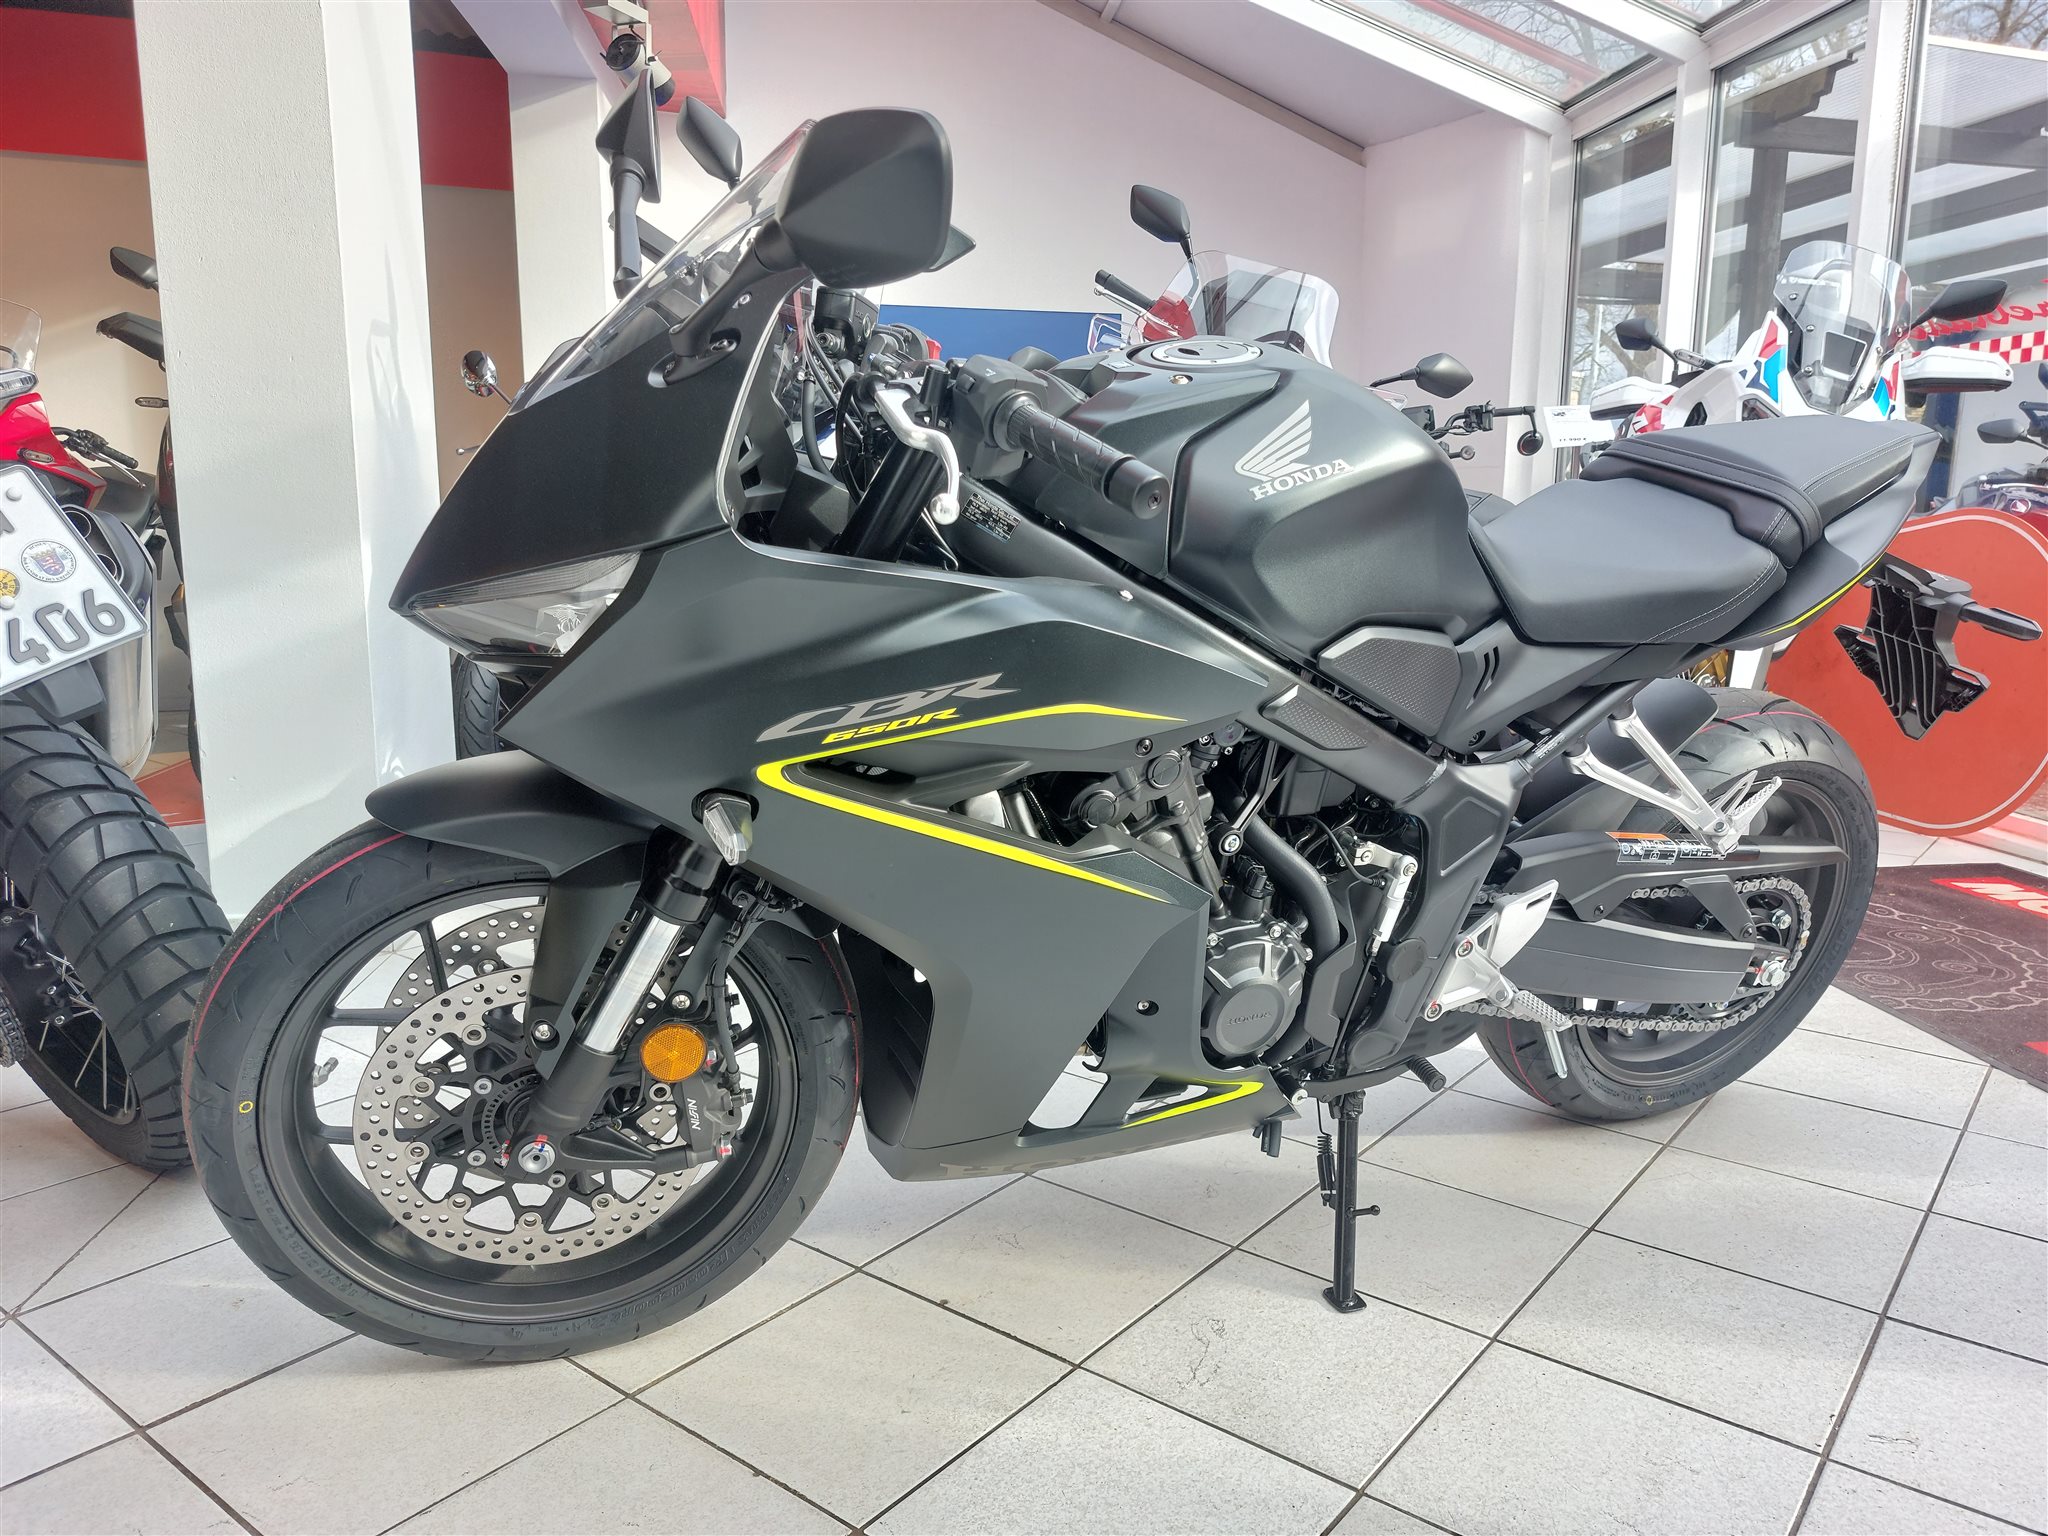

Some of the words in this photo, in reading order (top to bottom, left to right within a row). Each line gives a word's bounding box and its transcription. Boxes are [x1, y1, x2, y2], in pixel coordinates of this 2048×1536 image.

[1248, 459, 1354, 501] HONDA
[756, 672, 1021, 742] CBR
[821, 708, 964, 744] 650R
[686, 1098, 701, 1130] NISSIN
